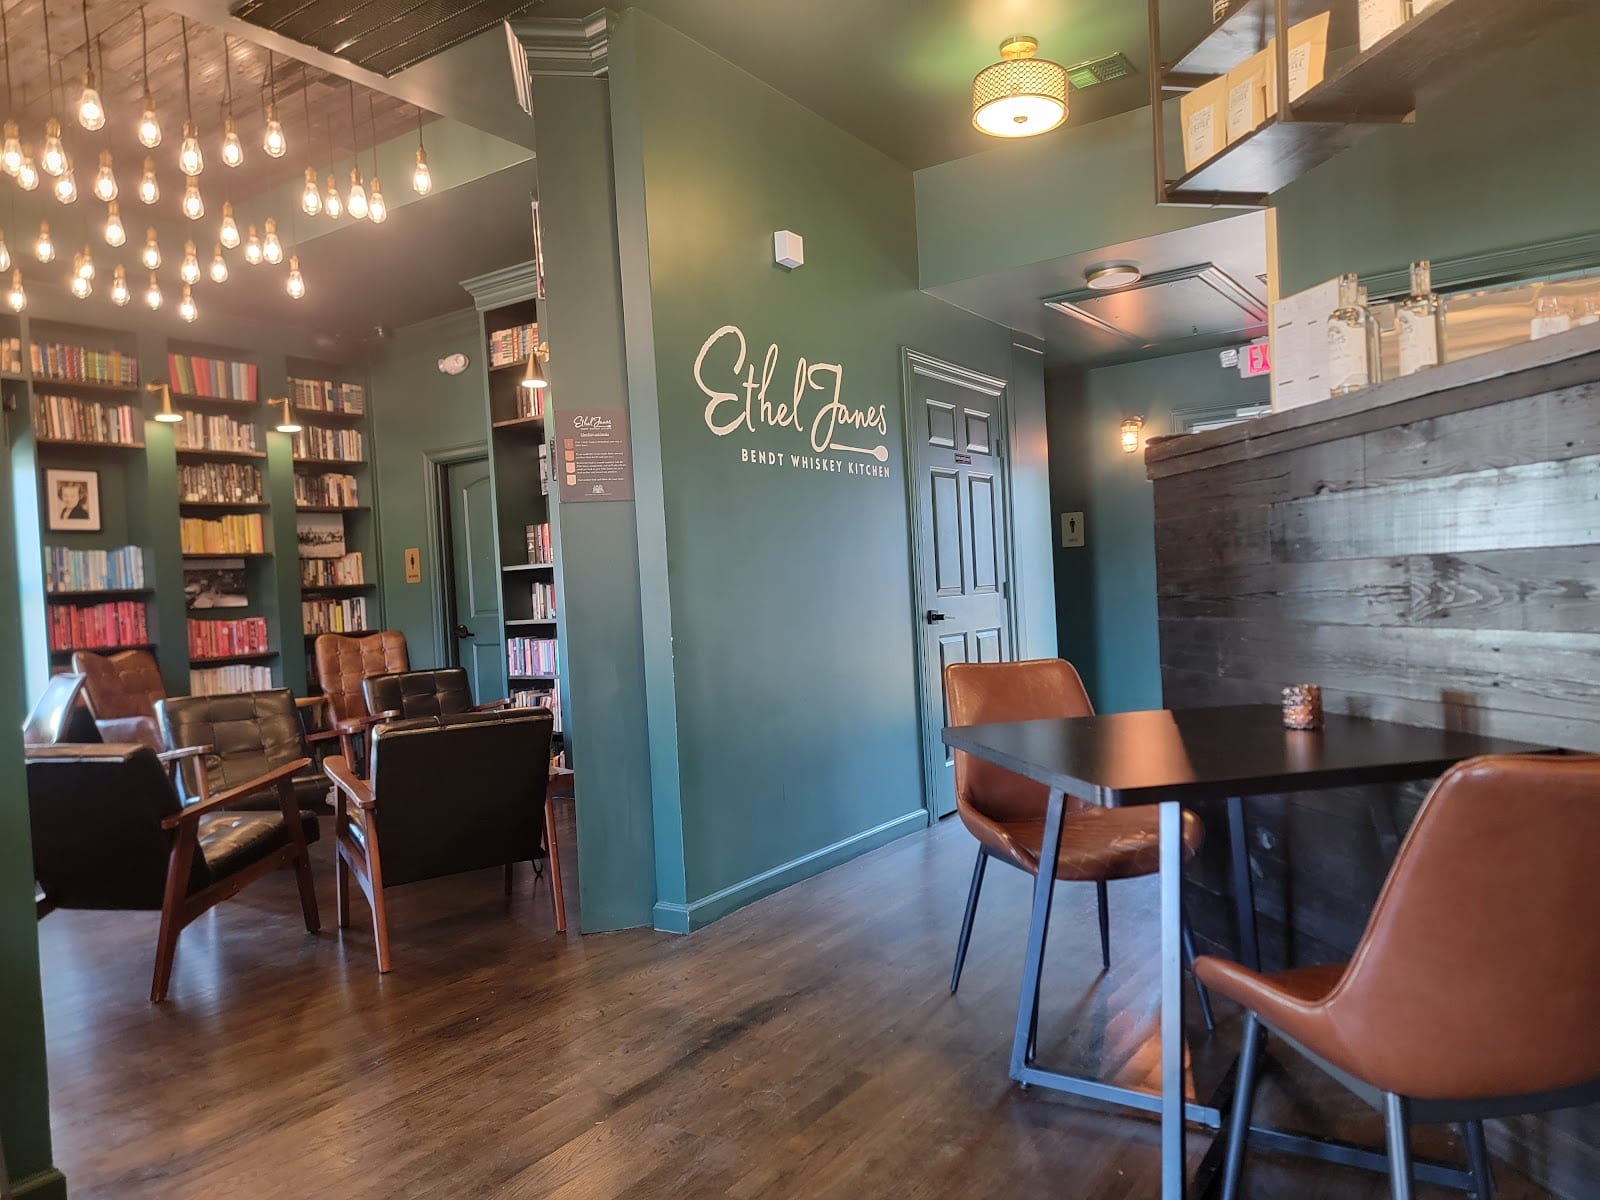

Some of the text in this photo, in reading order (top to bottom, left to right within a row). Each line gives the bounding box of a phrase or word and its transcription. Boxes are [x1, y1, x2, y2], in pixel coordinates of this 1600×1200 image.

[693, 325, 888, 453] Ethel Janes
[573, 415, 593, 428] Ethel
[741, 448, 891, 478] BENDT WHISKEY KITCHEN
